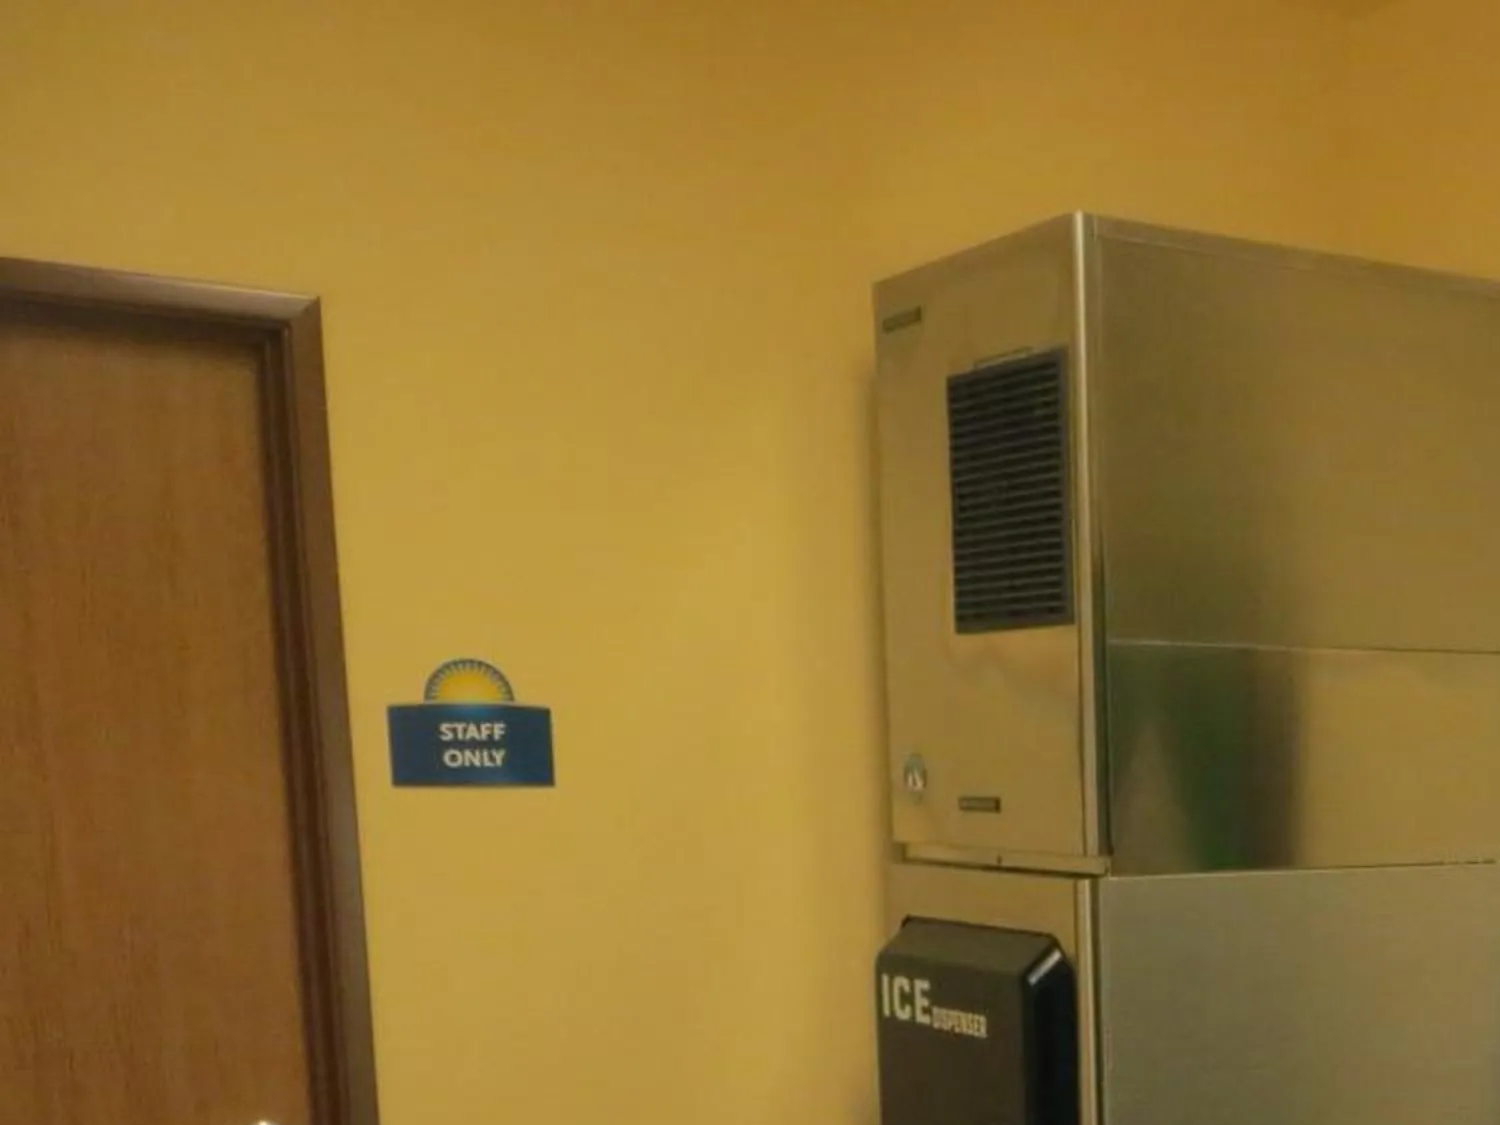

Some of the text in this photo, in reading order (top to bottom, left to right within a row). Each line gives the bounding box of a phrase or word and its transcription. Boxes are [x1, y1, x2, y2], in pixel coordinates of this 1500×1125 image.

[439, 723, 506, 741] STAFF
[443, 750, 506, 768] ONLY
[881, 973, 988, 1038] ICE DISPENSER
